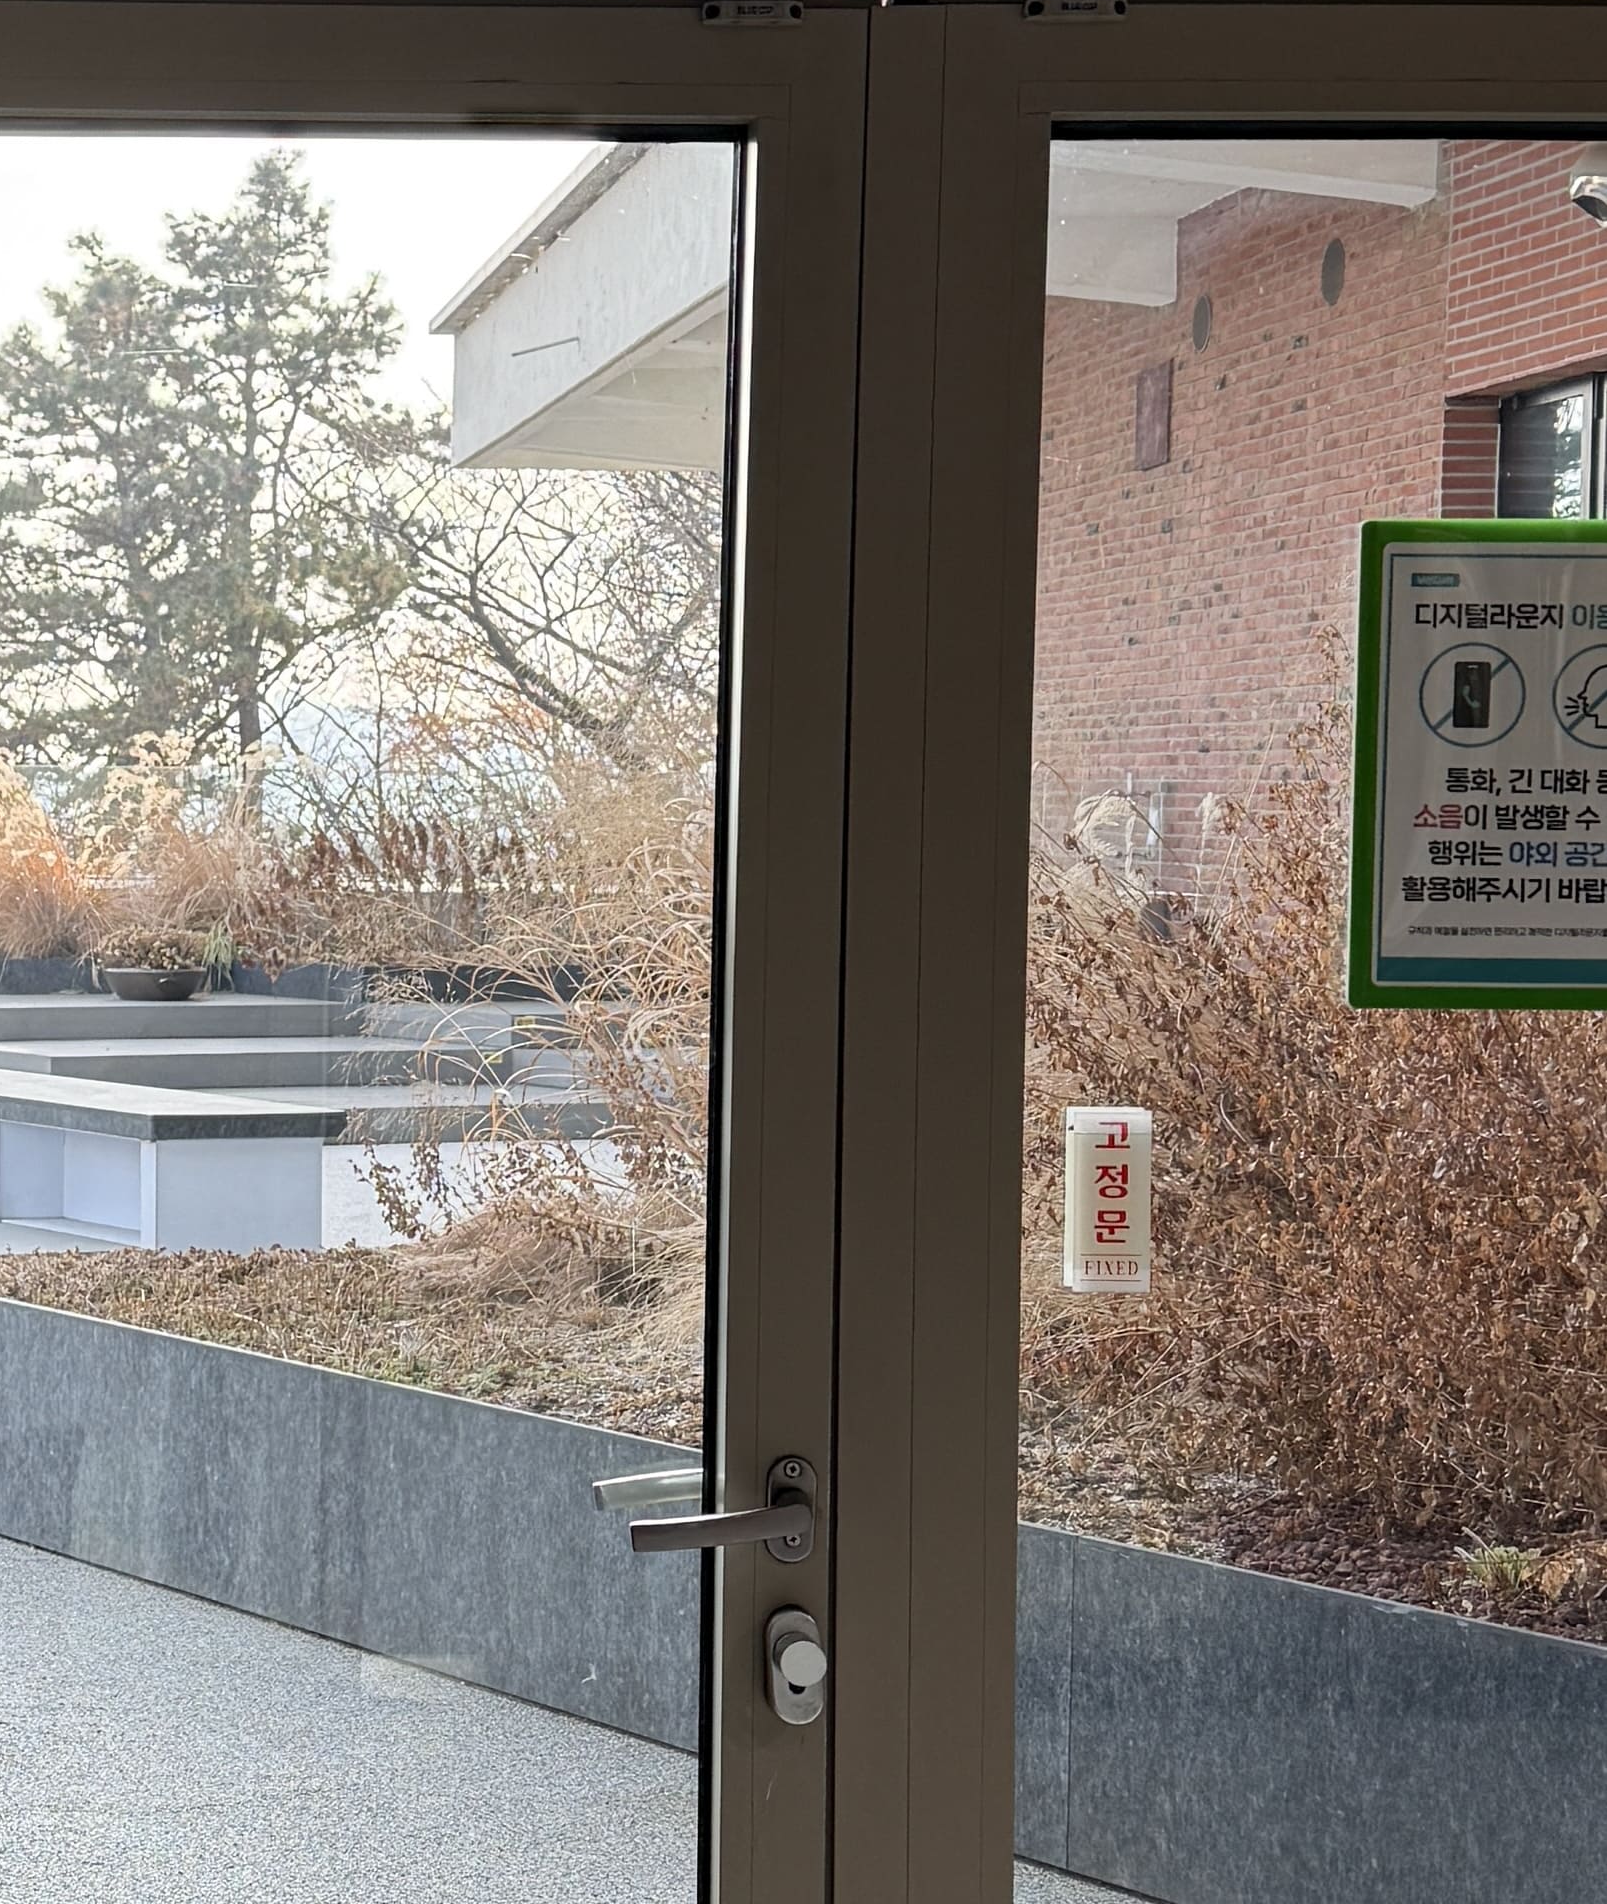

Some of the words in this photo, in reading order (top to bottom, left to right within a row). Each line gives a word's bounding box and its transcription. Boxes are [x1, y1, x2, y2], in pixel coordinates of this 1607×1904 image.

[1415, 603, 1564, 630] 디지털라운지
[1445, 767, 1502, 796] 통화,
[1508, 768, 1533, 794] 긴
[1540, 769, 1591, 795] 대화
[1413, 804, 1488, 830] 소음이
[1495, 804, 1570, 831] 발생할
[1575, 805, 1601, 831] 수
[1428, 840, 1503, 866] 행위는
[1509, 841, 1558, 867] 야외
[1401, 876, 1551, 904] 활용해주시기
[1558, 878, 1607, 904] 바람
[1094, 1122, 1131, 1244] 고정문
[1084, 1260, 1139, 1276] FIXED
